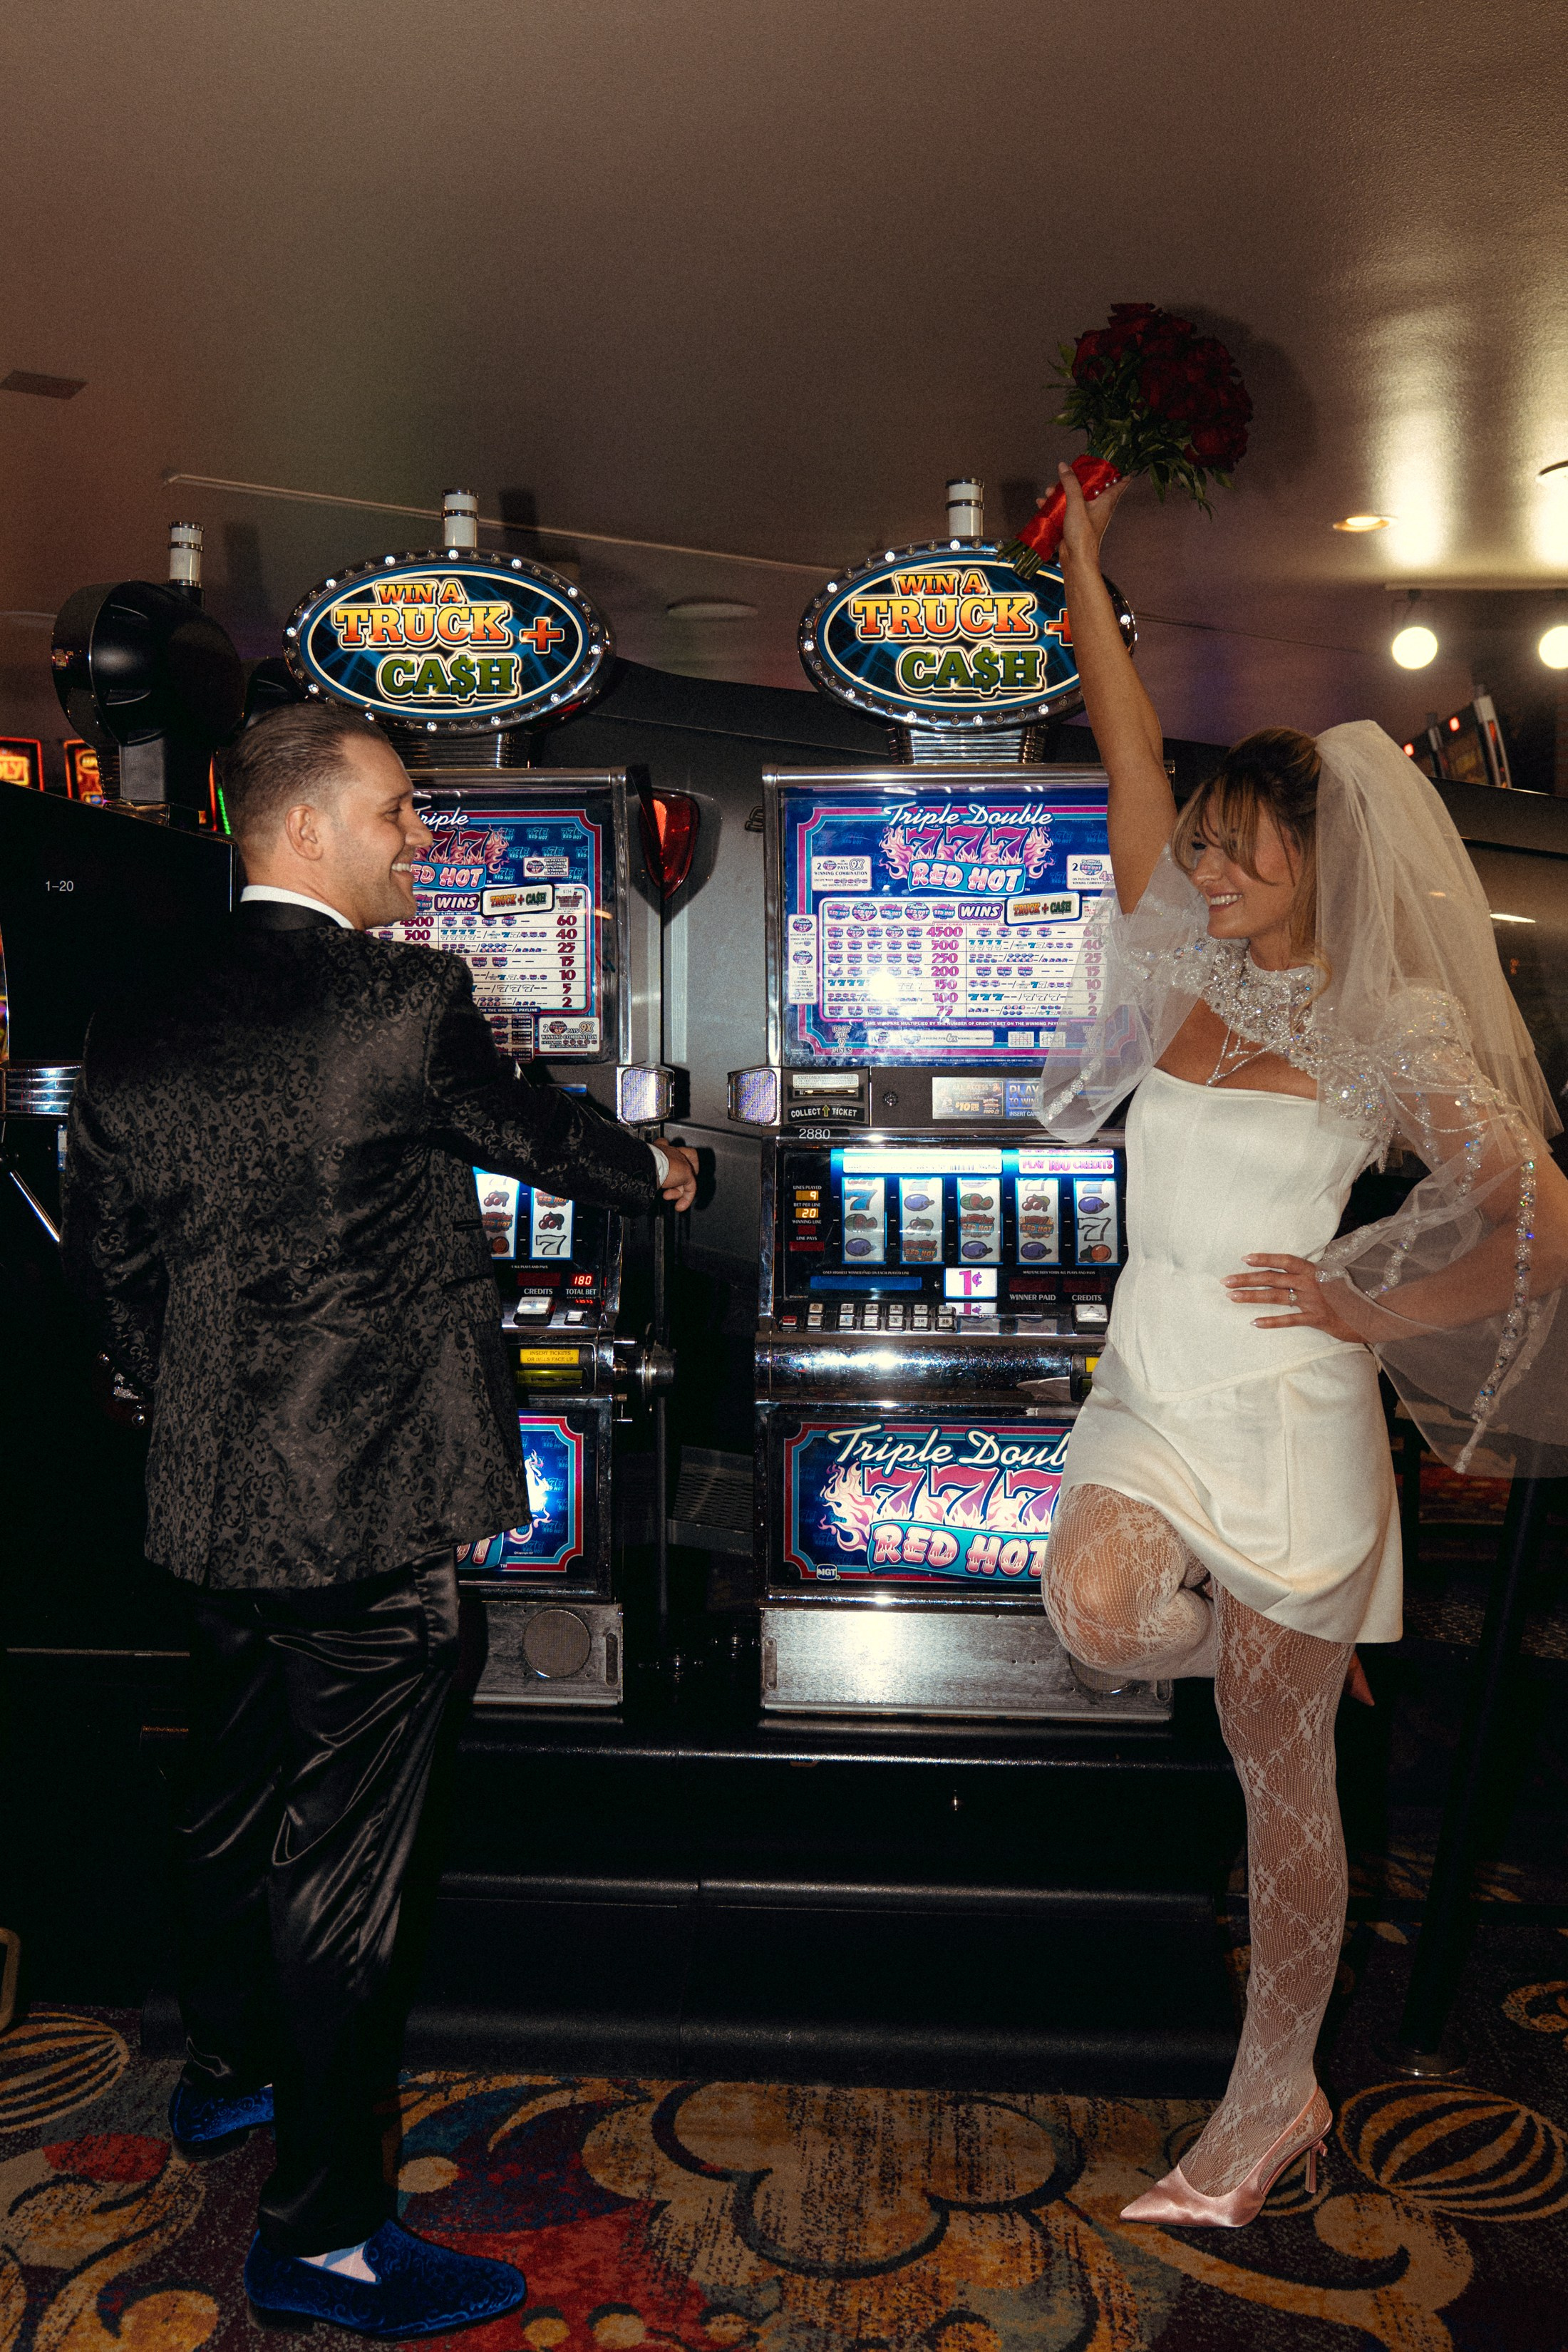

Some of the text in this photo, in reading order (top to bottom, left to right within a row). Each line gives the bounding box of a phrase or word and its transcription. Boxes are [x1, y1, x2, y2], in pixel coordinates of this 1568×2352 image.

[898, 574, 986, 594] WIN A
[378, 583, 465, 604] WIN A
[854, 598, 1031, 636] TRUCK
[336, 607, 507, 644] TRUCK
[901, 646, 1040, 691] CA$H
[381, 654, 515, 699] CA$H
[884, 801, 1053, 832] Triple Double
[906, 825, 1031, 863] 777
[409, 865, 484, 887] ED HOT
[912, 862, 1023, 892] RED HOT
[45, 880, 74, 892] 1-20
[437, 897, 477, 909] WINS
[490, 894, 516, 907] TRUCK
[961, 905, 1000, 917] WINS
[1013, 902, 1041, 916] TRUCK
[557, 914, 577, 926] 60
[404, 929, 431, 941] 500
[556, 928, 577, 939] 40
[927, 927, 963, 937] 4500
[557, 942, 575, 953] 25
[931, 939, 959, 950] 500
[559, 956, 574, 966] 15
[932, 953, 959, 963] 250
[559, 969, 576, 980] 10
[931, 966, 959, 976] 200
[1085, 966, 1100, 976] 15
[562, 984, 572, 994] 5
[934, 979, 958, 990] 150
[1085, 979, 1101, 989] 10
[562, 997, 572, 1007] 2
[932, 992, 959, 1003] 100
[1088, 993, 1097, 1003] 5
[936, 1006, 954, 1016] 75
[1088, 1006, 1098, 1016] 2
[1009, 1085, 1039, 1097] PLAY
[790, 1108, 857, 1118] COLLECT TICKET
[798, 1128, 830, 1140] 2880
[1022, 1160, 1113, 1171] PLAY 180 CREDITS
[810, 1191, 817, 1200] 9
[802, 1208, 817, 1218] 20
[1022, 1224, 1036, 1232] RED
[574, 1276, 592, 1285] 180
[959, 1270, 982, 1296] 1¢
[827, 1424, 1071, 1475] Triple Doub
[874, 1523, 1048, 1577] RED HOT
